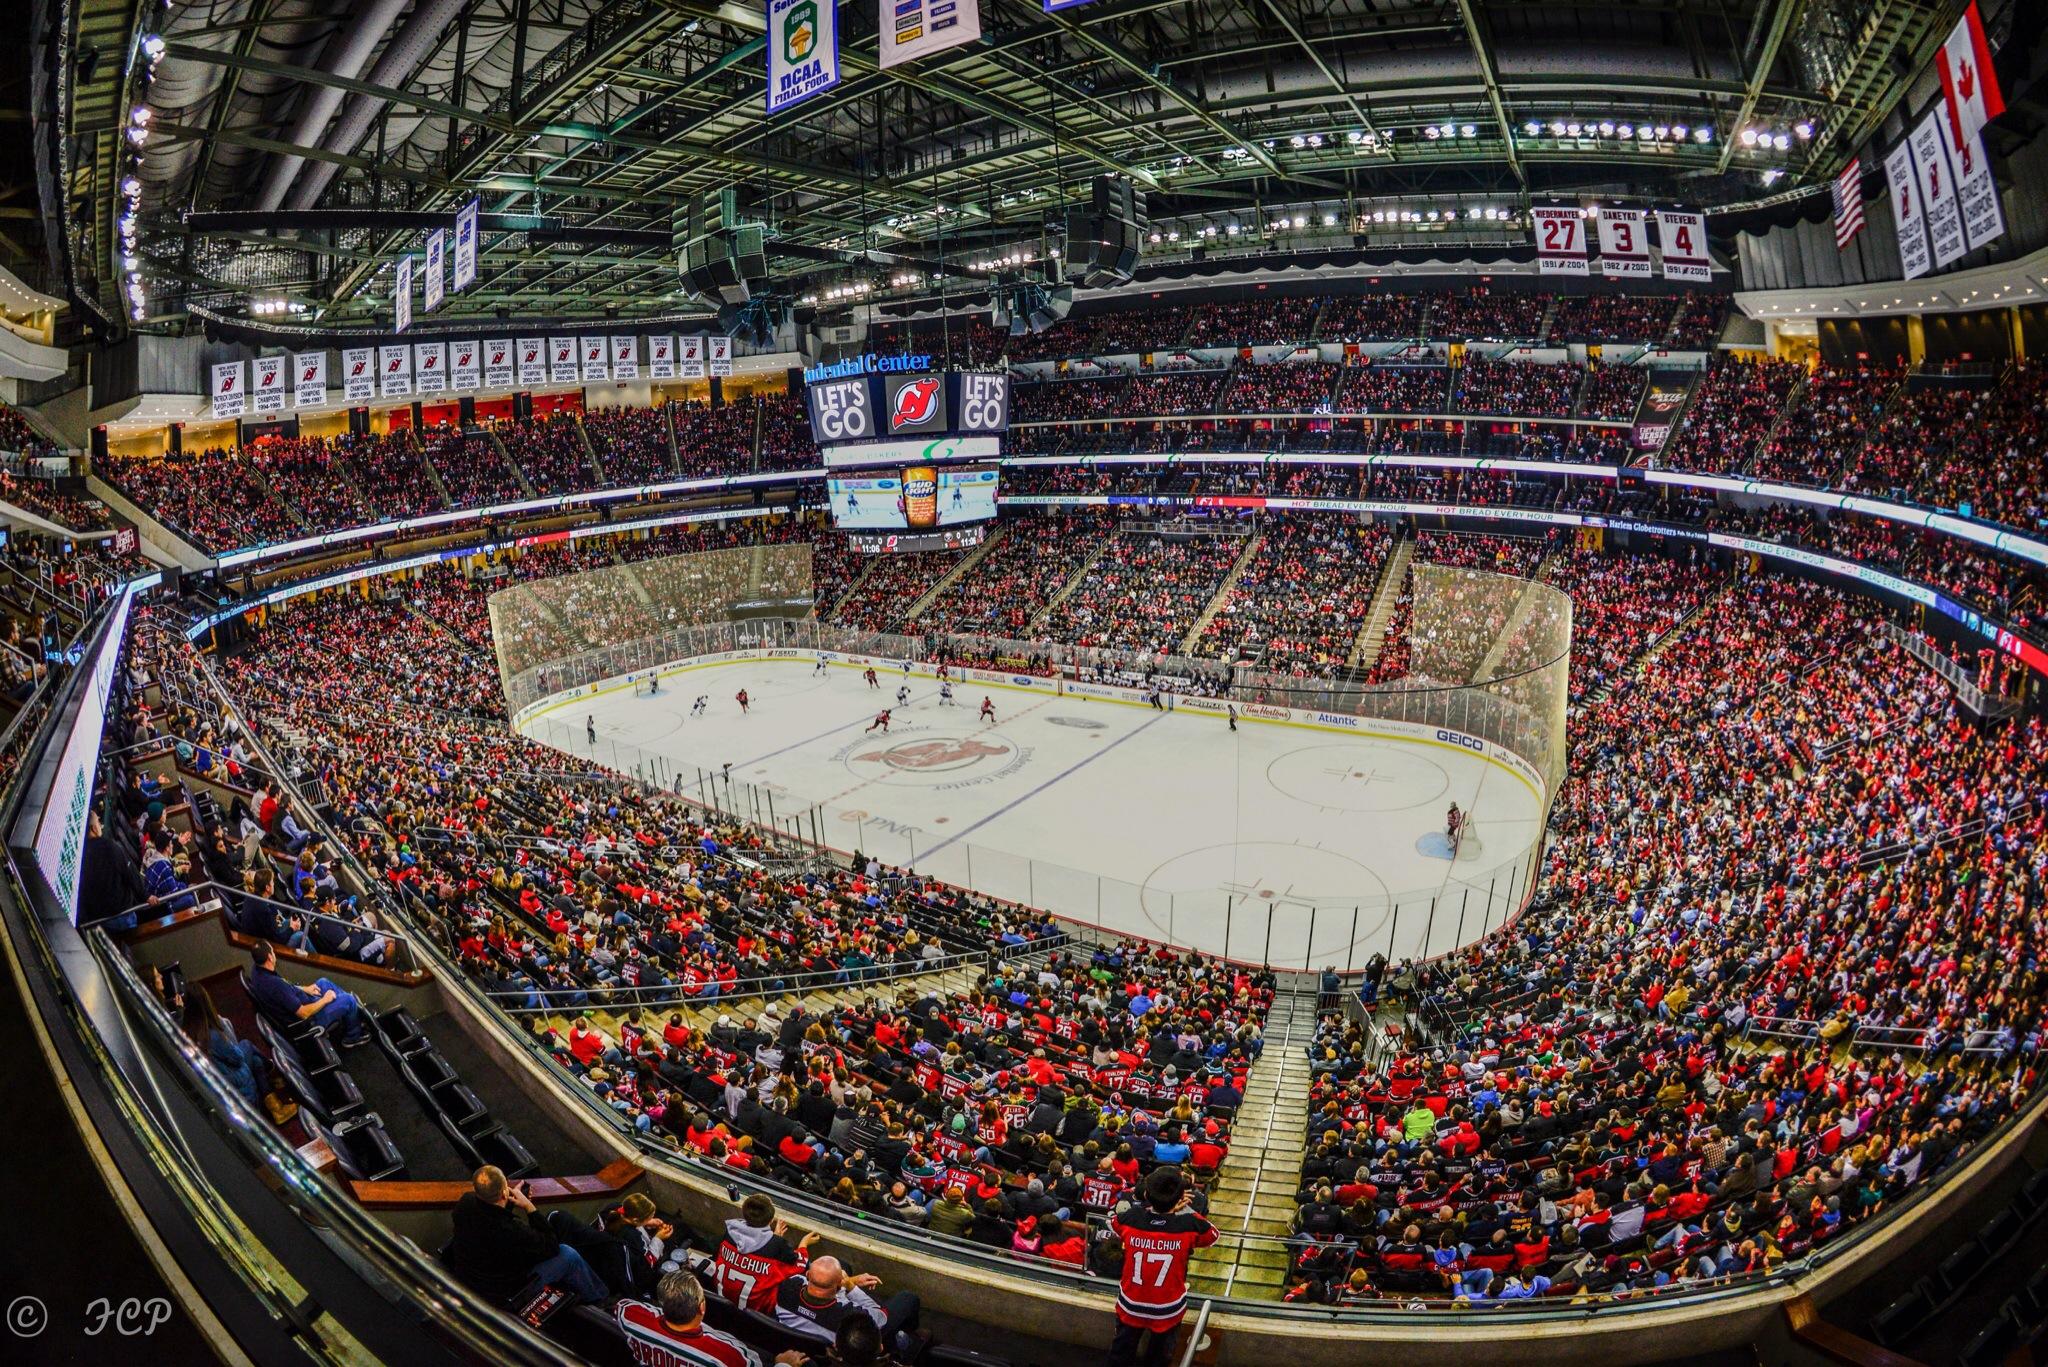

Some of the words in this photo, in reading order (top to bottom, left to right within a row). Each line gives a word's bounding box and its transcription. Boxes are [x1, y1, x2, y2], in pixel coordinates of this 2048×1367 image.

[791, 8, 811, 25] 1989
[775, 86, 802, 104] FINAL
[805, 72, 829, 91] FOUR
[1603, 211, 1637, 221] DANEYKO
[1664, 213, 1697, 225] STEVENS
[1542, 220, 1575, 250] 27
[1612, 223, 1633, 252] 3
[1675, 225, 1693, 256] 4
[1541, 260, 1557, 268] 1991
[1567, 260, 1586, 269] 2004
[1603, 261, 1620, 270] 1982
[1631, 263, 1649, 272] 2003
[1666, 265, 1681, 274] 1991
[1690, 267, 1708, 276] 2005
[260, 364, 278, 372] DEVILS
[864, 351, 931, 373] Center
[220, 369, 237, 377] DEVILS
[965, 375, 1004, 401] LET'S
[257, 395, 281, 404] CHAMPIONS
[817, 381, 865, 411] LET'S
[964, 399, 1001, 429] GO
[821, 406, 866, 438] GO
[904, 486, 936, 495] LIGHT
[909, 480, 933, 489] BUD
[1008, 496, 1032, 504] BREAD
[1176, 497, 1194, 505] 11:07
[1291, 500, 1311, 508] HOT
[1313, 501, 1345, 510] BREAD
[1379, 503, 1408, 512] HOUR
[672, 516, 689, 524] HOT
[690, 513, 715, 522] BREAD
[716, 511, 740, 519] EVERY
[741, 508, 763, 516] HOUR
[1436, 506, 1456, 514] HOT
[1458, 508, 1492, 516] BREAD
[1493, 509, 1524, 519] EVERY
[1526, 512, 1554, 521] HOUR
[593, 525, 619, 533] BREAD
[619, 522, 642, 530] EVERY
[643, 519, 665, 527] HOUR
[1609, 519, 1633, 531] Harlem
[1633, 522, 1677, 536] Globetrotters
[862, 543, 880, 553] 11:06
[961, 537, 977, 547] 11:06
[1723, 537, 1742, 546] HOT
[1743, 540, 1773, 553] BREAD
[1775, 546, 1800, 560] EVERY
[1802, 554, 1825, 567] HOUR
[351, 570, 365, 579] HOT
[366, 564, 389, 576] BREAD
[390, 559, 412, 571] EVERY
[413, 555, 433, 566] HOUR
[274, 591, 285, 601] HOT
[285, 585, 305, 596] BREAD
[305, 580, 326, 591] EVERY
[326, 576, 345, 586] HOUR
[1244, 703, 1260, 715] Tim
[1260, 706, 1289, 720] Hortons
[1318, 712, 1357, 727] Atlantic
[1436, 729, 1483, 752] GEICO
[864, 815, 923, 838] PNC
[1056, 1023, 1072, 1037] 26
[625, 1037, 632, 1050] 4
[918, 1074, 926, 1087] 9
[1108, 1076, 1124, 1090] 17
[942, 1084, 958, 1099] 15
[979, 1127, 996, 1140] 30
[951, 1171, 970, 1182] ZAJAC
[1378, 1173, 1397, 1182] PARISE
[1088, 1179, 1113, 1190] BRODEUR
[1087, 1186, 1111, 1208] 30
[1130, 1236, 1182, 1251] KOVALCHUK
[1131, 1251, 1174, 1287] 17
[717, 1263, 757, 1311] 17
